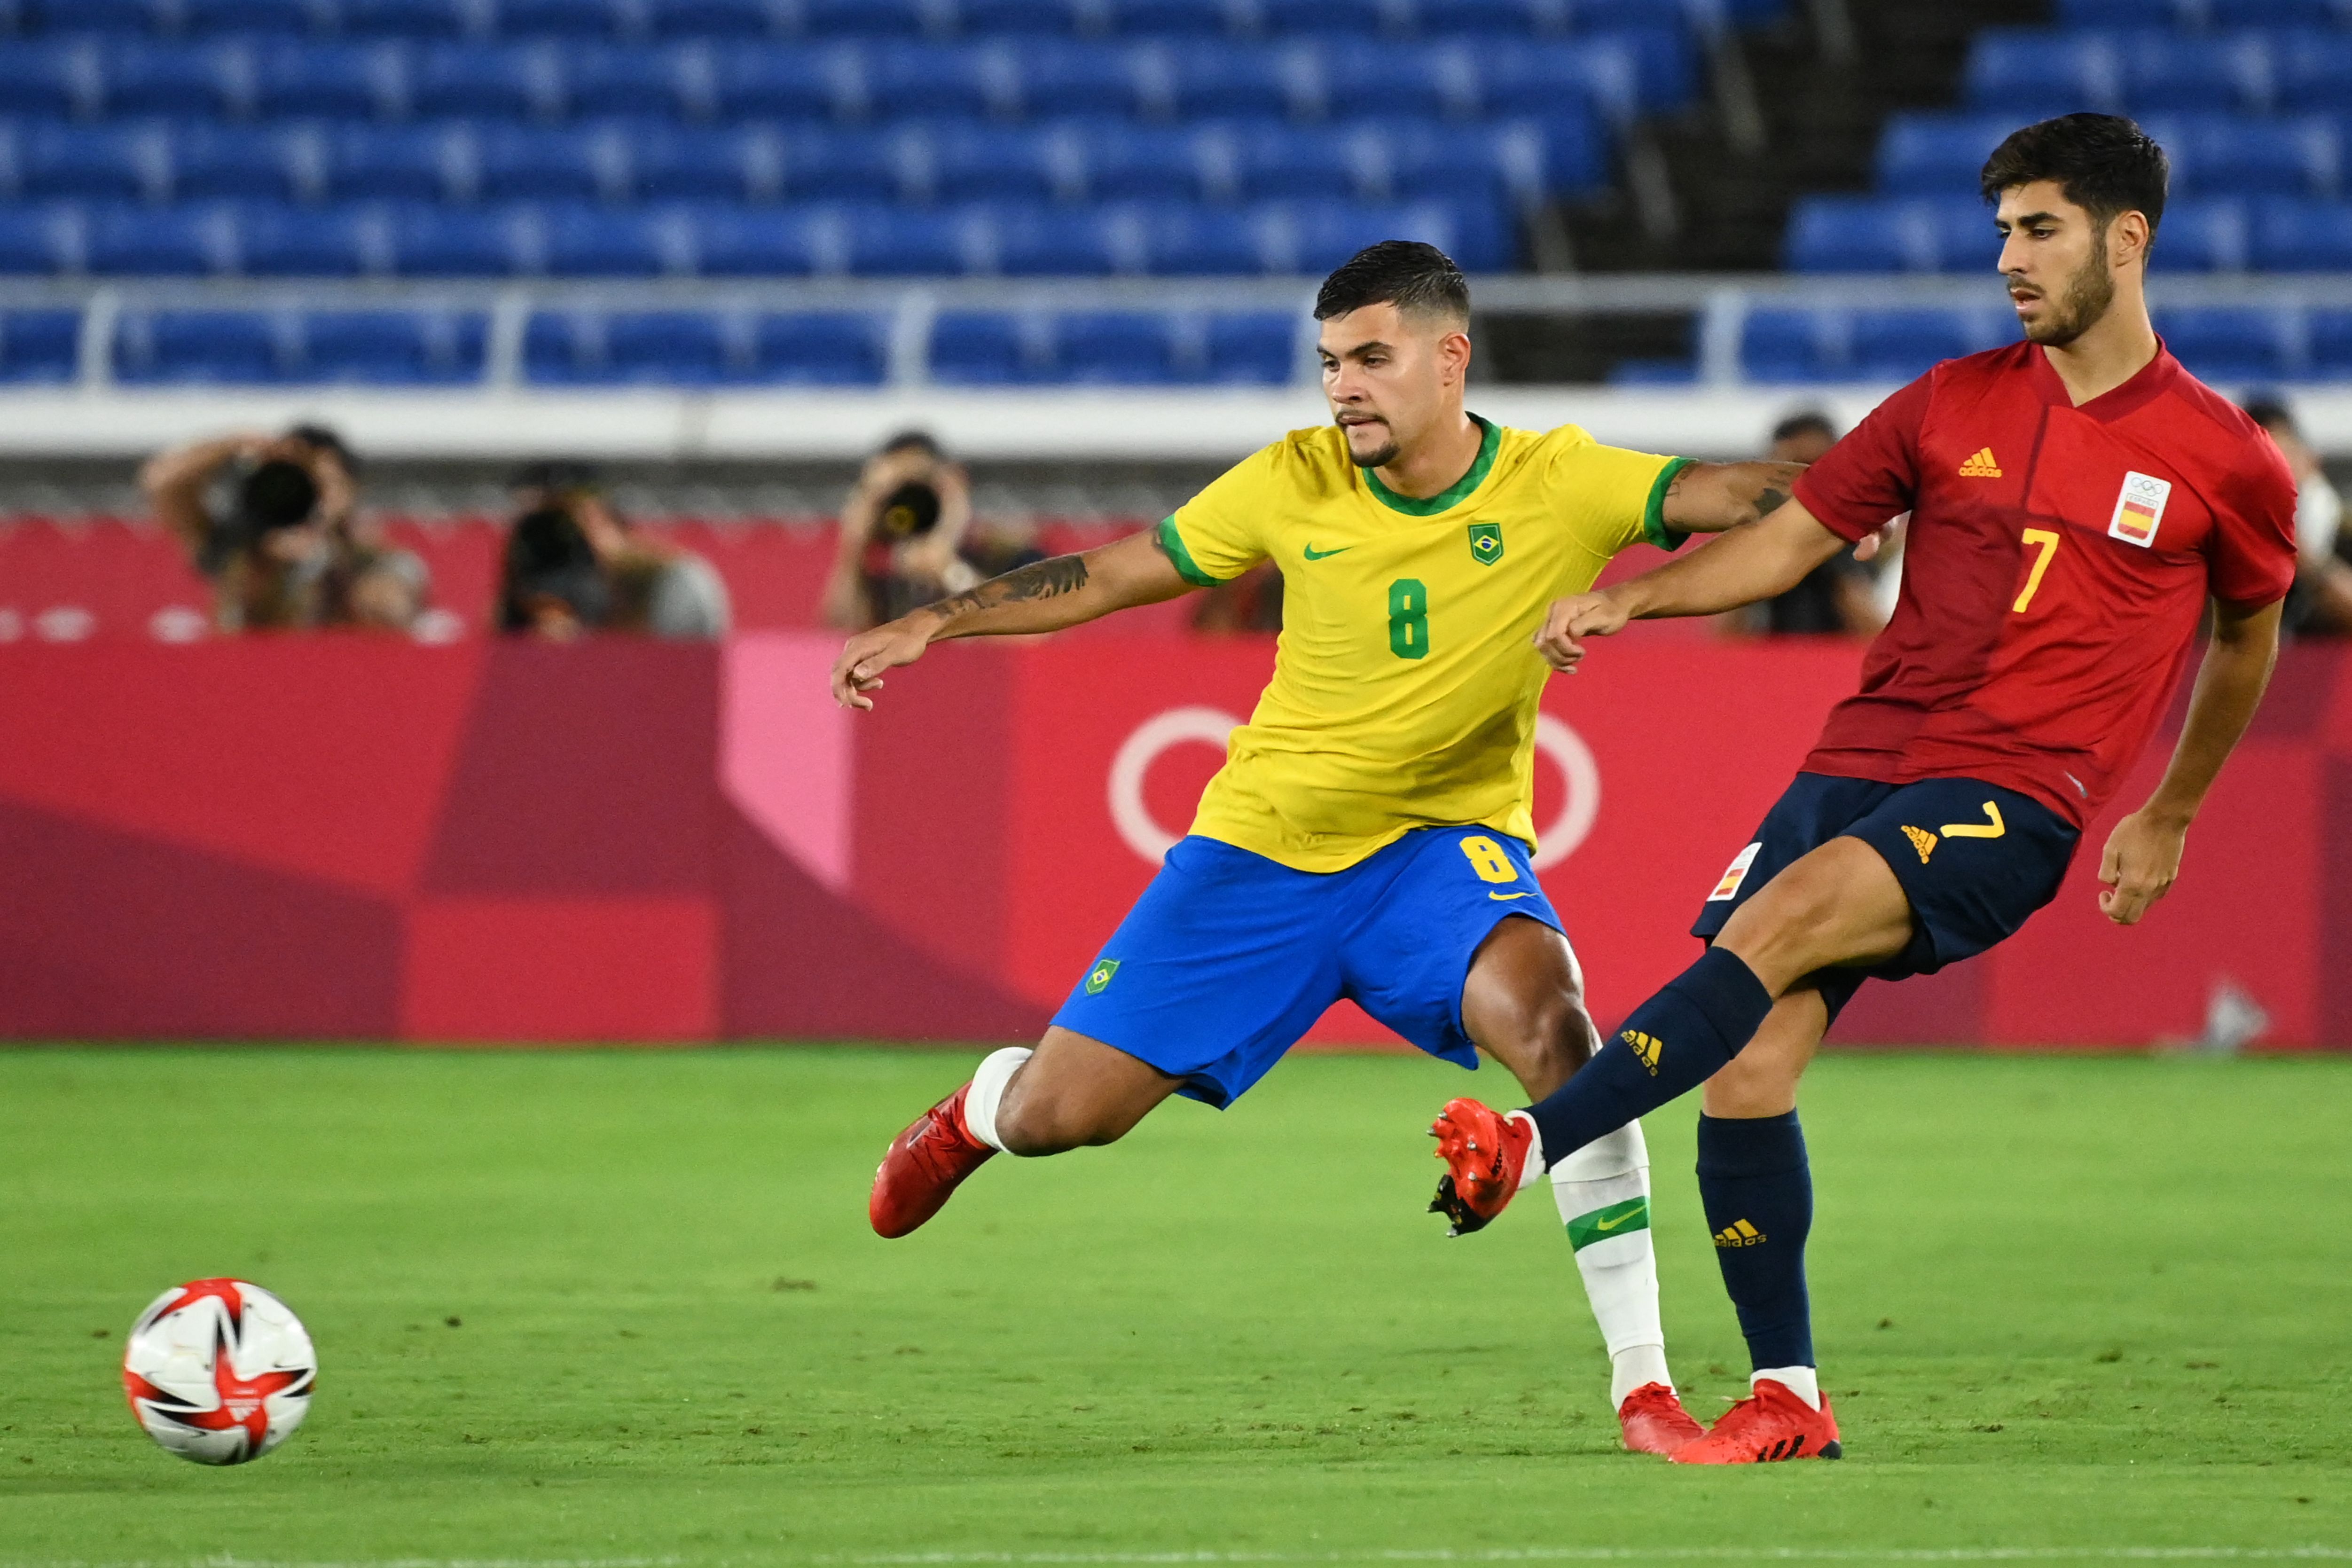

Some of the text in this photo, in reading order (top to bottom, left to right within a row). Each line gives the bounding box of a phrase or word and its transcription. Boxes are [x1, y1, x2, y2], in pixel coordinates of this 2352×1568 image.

[2012, 528, 2060, 613] 7
[1388, 578, 1429, 659] 8
[1939, 800, 2005, 838] 7
[1459, 836, 1519, 884] 8
